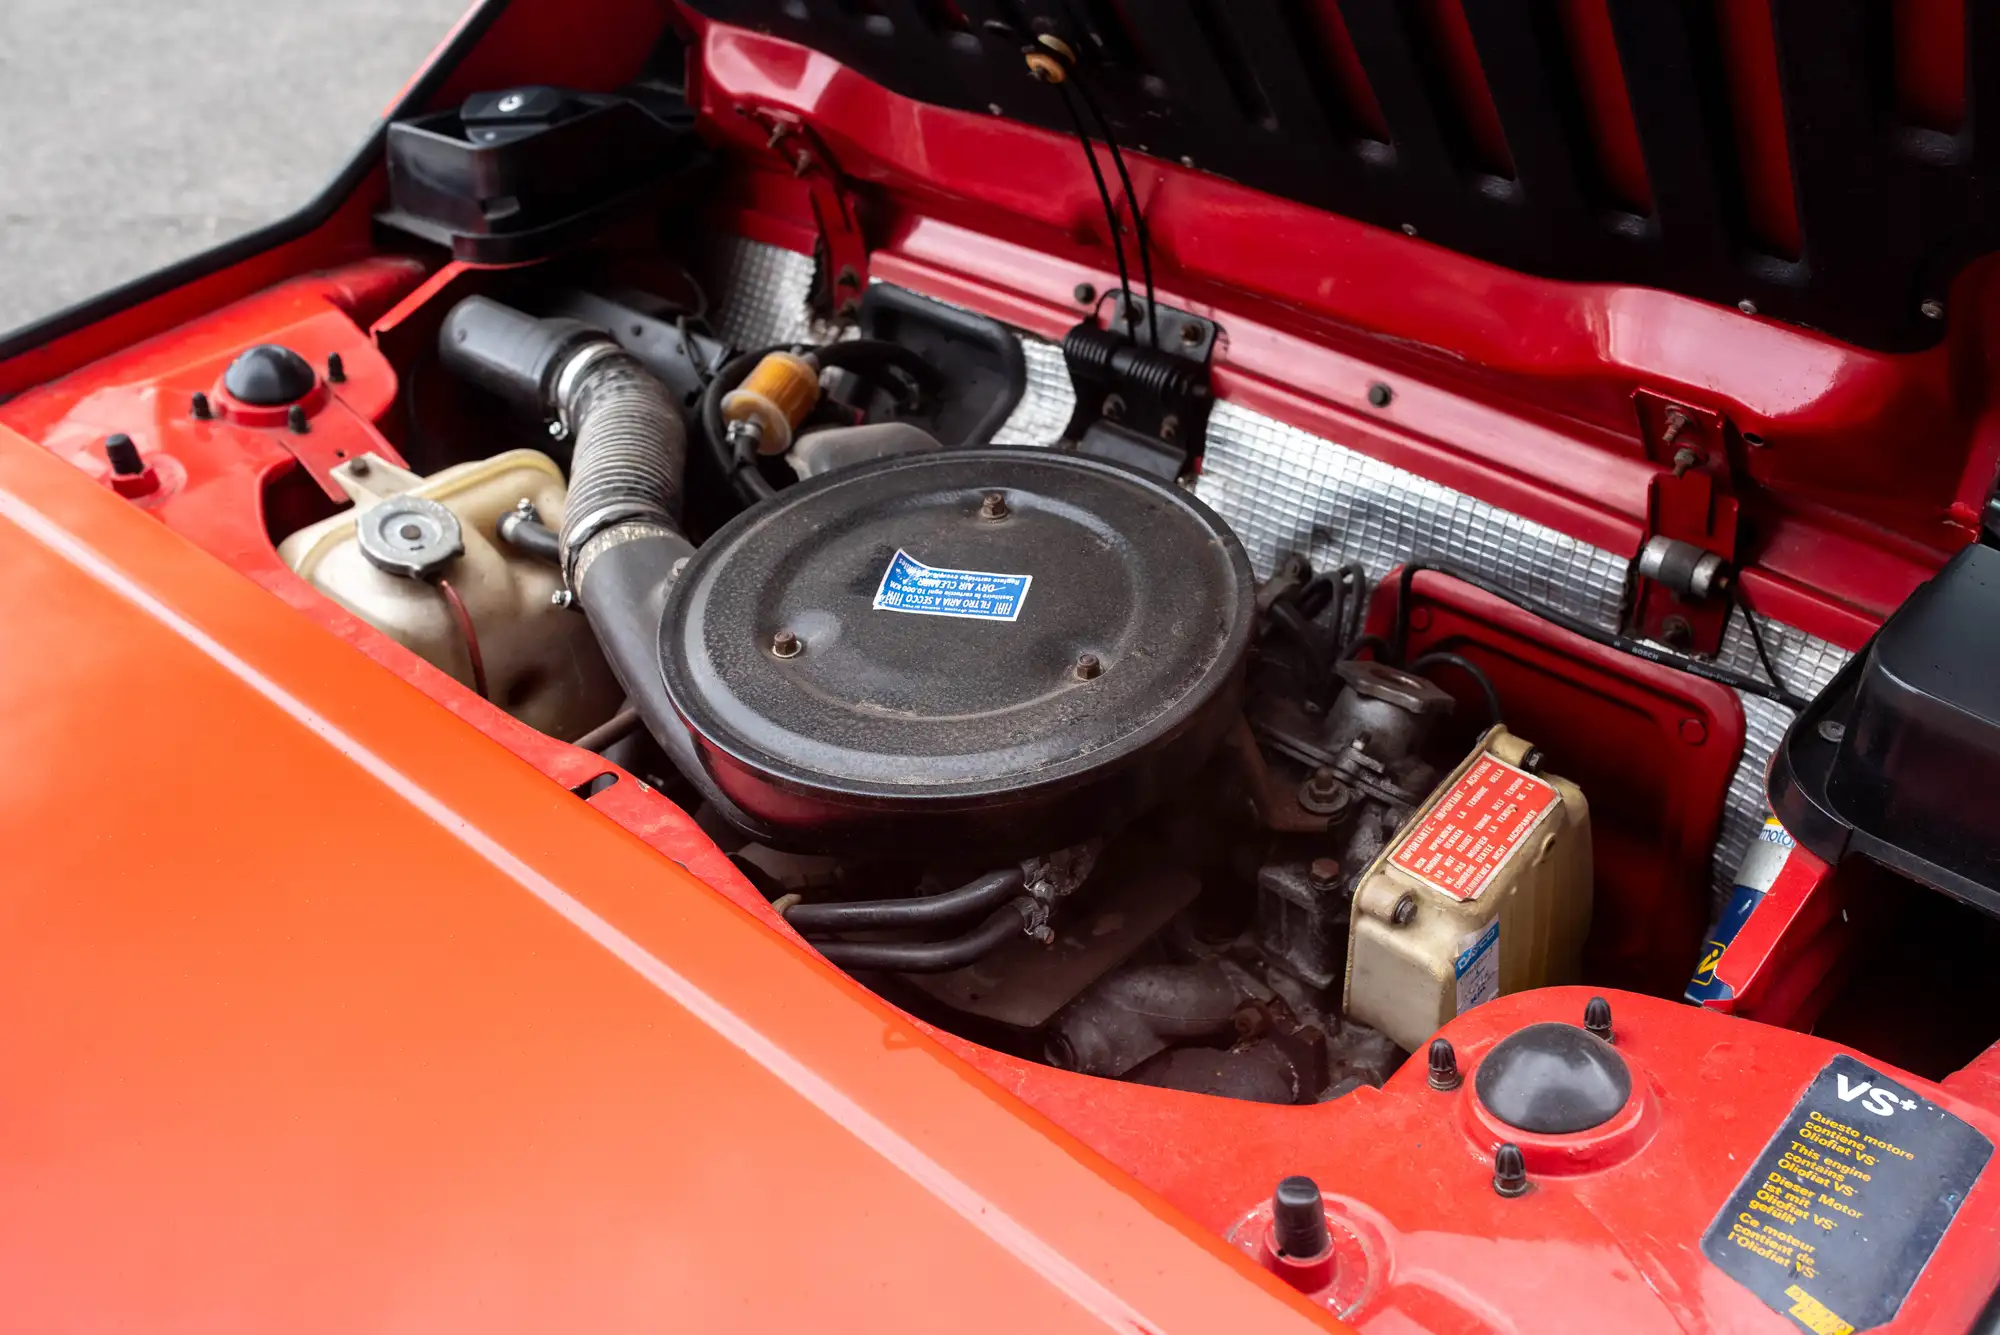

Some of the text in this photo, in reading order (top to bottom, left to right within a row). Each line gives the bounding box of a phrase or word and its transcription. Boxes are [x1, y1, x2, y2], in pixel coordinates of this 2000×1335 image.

[958, 581, 974, 590] AIR
[959, 574, 991, 583] cartridge
[976, 583, 995, 593] DRY
[906, 594, 991, 609] FILTRO ARIA A SECCO
[992, 602, 1012, 615] FIAT
[1631, 646, 1659, 661] BOSCH
[1399, 825, 1434, 862] IMPORTANTE
[1434, 789, 1465, 821] IMPORTANT
[1465, 759, 1492, 786] ACHTUNG
[1413, 856, 1427, 869] NON
[1428, 822, 1456, 852] RIPRENDERE
[1456, 809, 1468, 819] LA
[1454, 861, 1467, 874] PAS
[1488, 824, 1499, 834] LA
[1525, 782, 1536, 791] LA
[1444, 855, 1457, 868] NOT
[1455, 834, 1475, 853] ADJUST
[1491, 844, 1508, 861] NICHT
[1799, 1127, 1851, 1156] Oliofiat
[1805, 1121, 1866, 1150] contiene
[1810, 1111, 1915, 1161] Questo motore
[1778, 1158, 1830, 1188] Oliofiat
[1785, 1152, 1844, 1182] contains
[1791, 1141, 1872, 1183] This engine
[1756, 1190, 1809, 1219] Oliofiat
[1763, 1182, 1811, 1209] ist mit
[1768, 1172, 1864, 1219] Dieser Motor
[1749, 1200, 1797, 1225] gefüllt
[1733, 1223, 1815, 1266] contient de
[1739, 1212, 1816, 1253] Ce moteur
